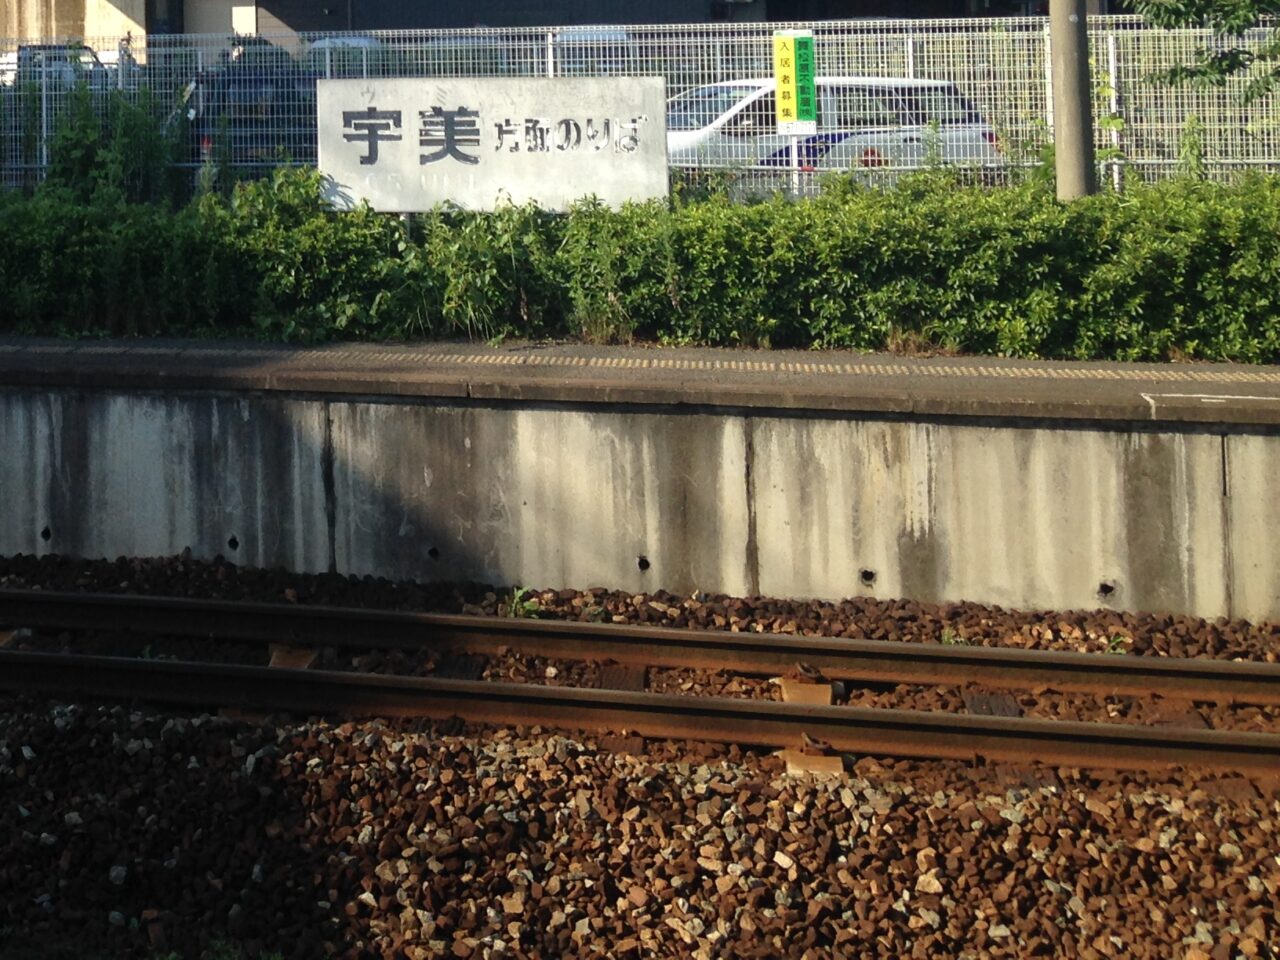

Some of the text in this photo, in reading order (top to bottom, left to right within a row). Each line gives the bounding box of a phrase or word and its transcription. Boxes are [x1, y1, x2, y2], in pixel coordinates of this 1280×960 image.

[779, 42, 793, 118] 入居者募集
